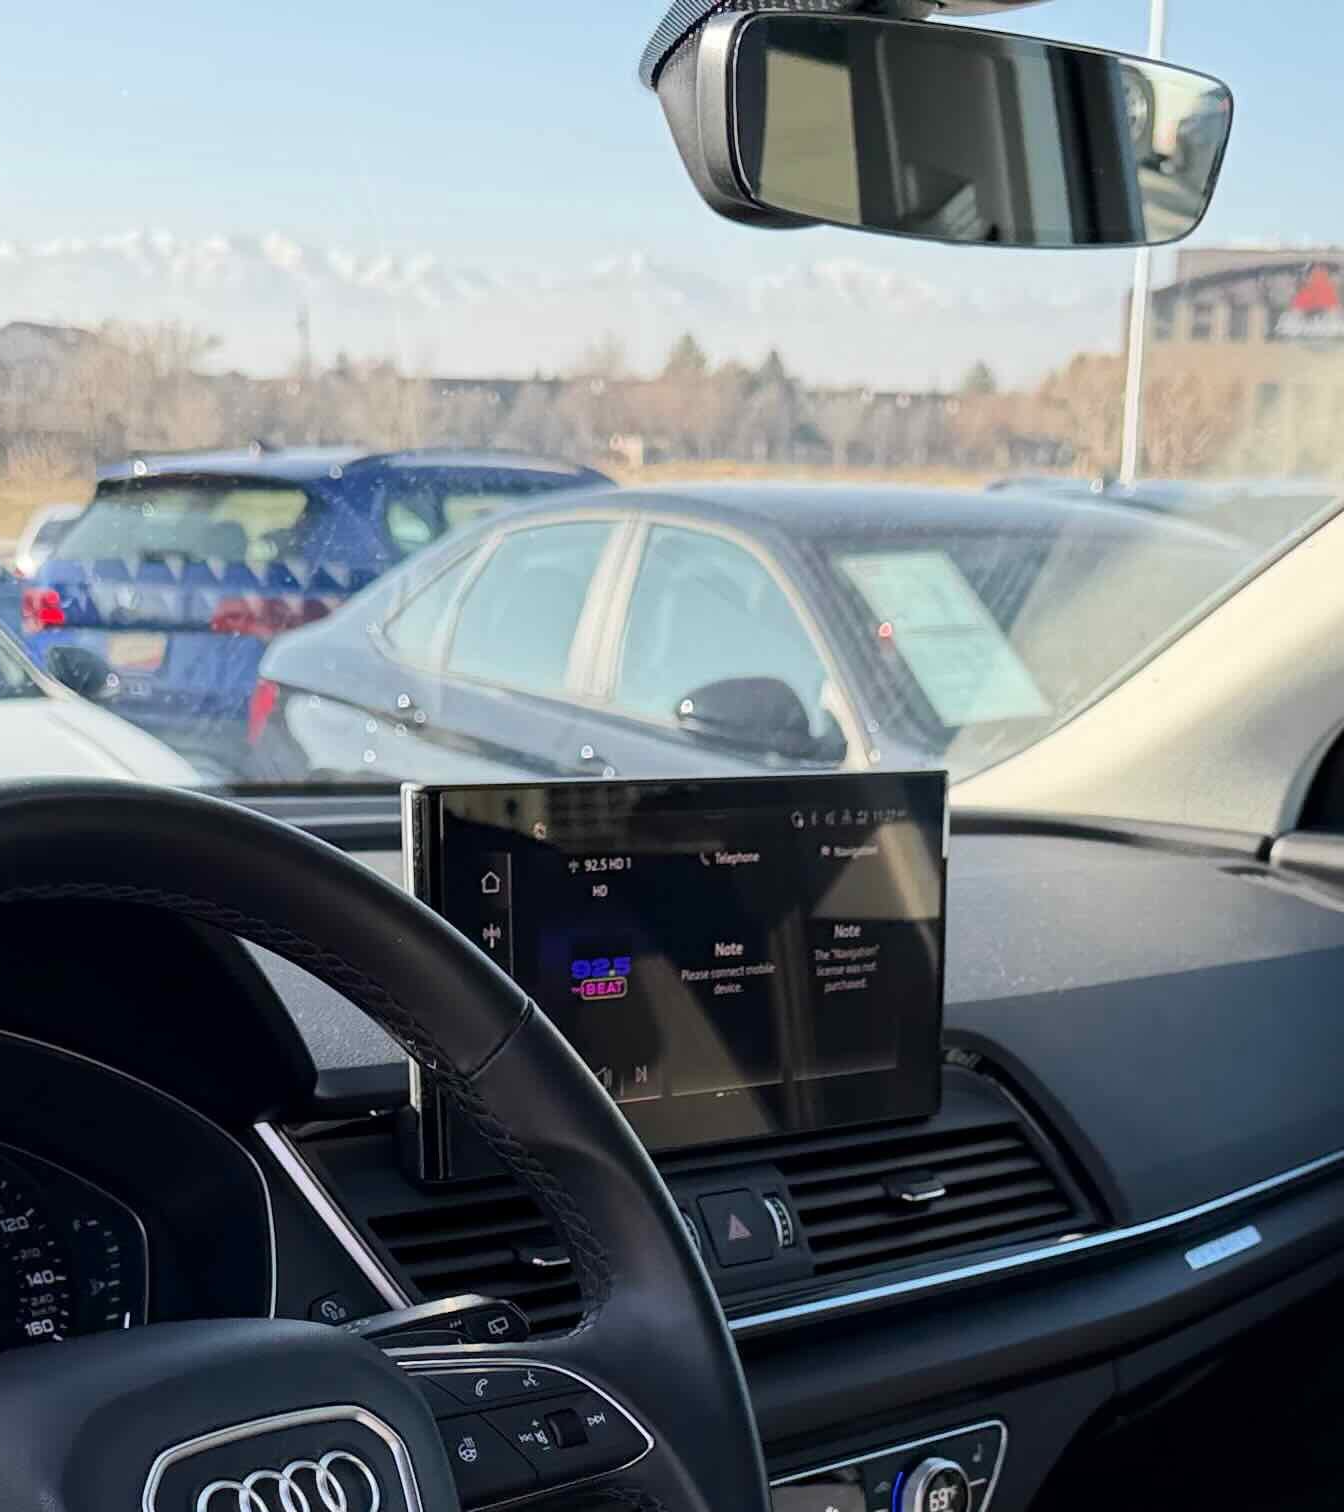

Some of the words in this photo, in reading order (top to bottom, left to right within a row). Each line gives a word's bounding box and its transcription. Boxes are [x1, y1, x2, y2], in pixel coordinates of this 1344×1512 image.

[584, 858, 608, 872] 92.5
[714, 851, 760, 866] Telephone
[833, 924, 862, 940] Note
[714, 942, 744, 958] Note
[570, 955, 633, 980] 92.5
[681, 969, 711, 982] Please
[711, 966, 745, 979] connect
[745, 963, 776, 976] mobile
[585, 981, 624, 996] BEAT
[713, 983, 744, 996] device.
[0, 1215, 30, 1233] 120
[25, 1269, 56, 1288] 140
[24, 1318, 56, 1336] 160
